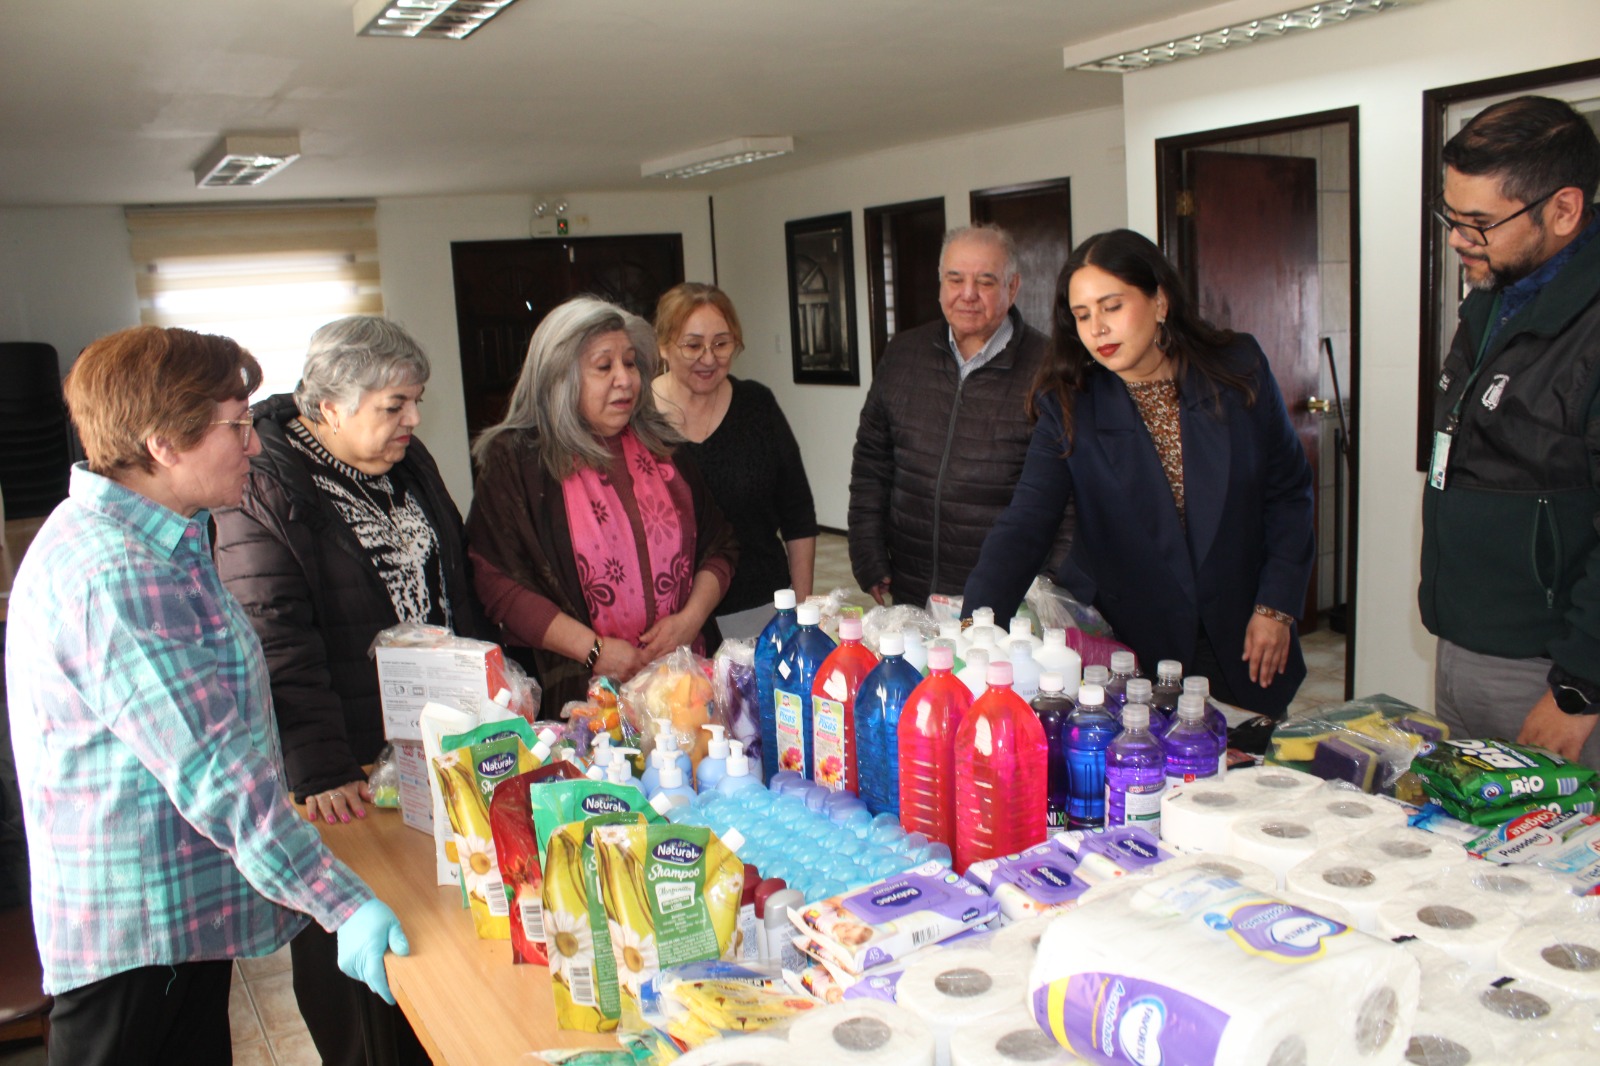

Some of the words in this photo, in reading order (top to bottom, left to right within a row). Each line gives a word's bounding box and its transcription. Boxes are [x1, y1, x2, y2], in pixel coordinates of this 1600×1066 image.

[481, 756, 512, 773] Natural
[586, 798, 621, 812] Natural
[1508, 811, 1557, 836] Colgate
[657, 844, 695, 859] Natural
[648, 863, 700, 882] Shampoo
[1103, 978, 1125, 1057] Acolchado
[1137, 1006, 1154, 1061] FAVORITA
